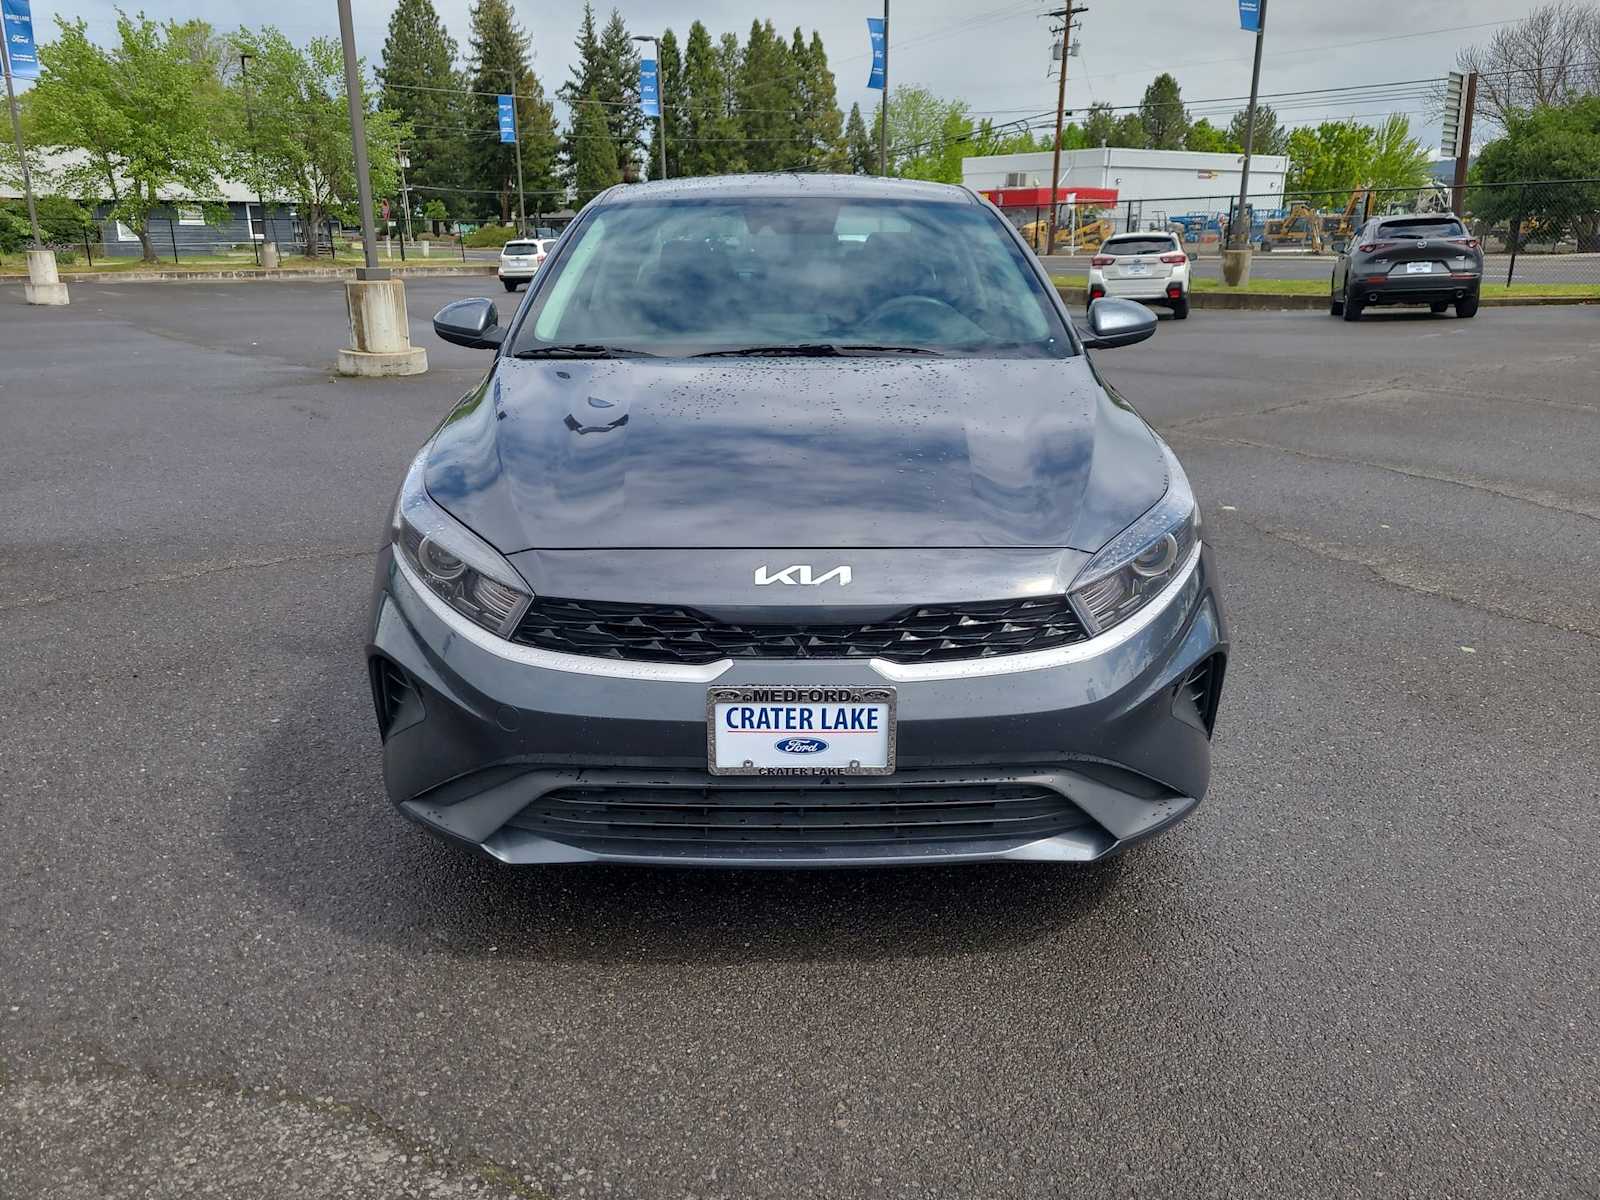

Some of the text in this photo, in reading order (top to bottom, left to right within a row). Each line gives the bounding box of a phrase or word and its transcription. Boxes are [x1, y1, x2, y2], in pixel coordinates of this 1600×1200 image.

[754, 565, 852, 586] KIA
[753, 689, 851, 702] MEDFORD
[726, 707, 878, 729] CRATER LAKE
[785, 740, 818, 752] Ford
